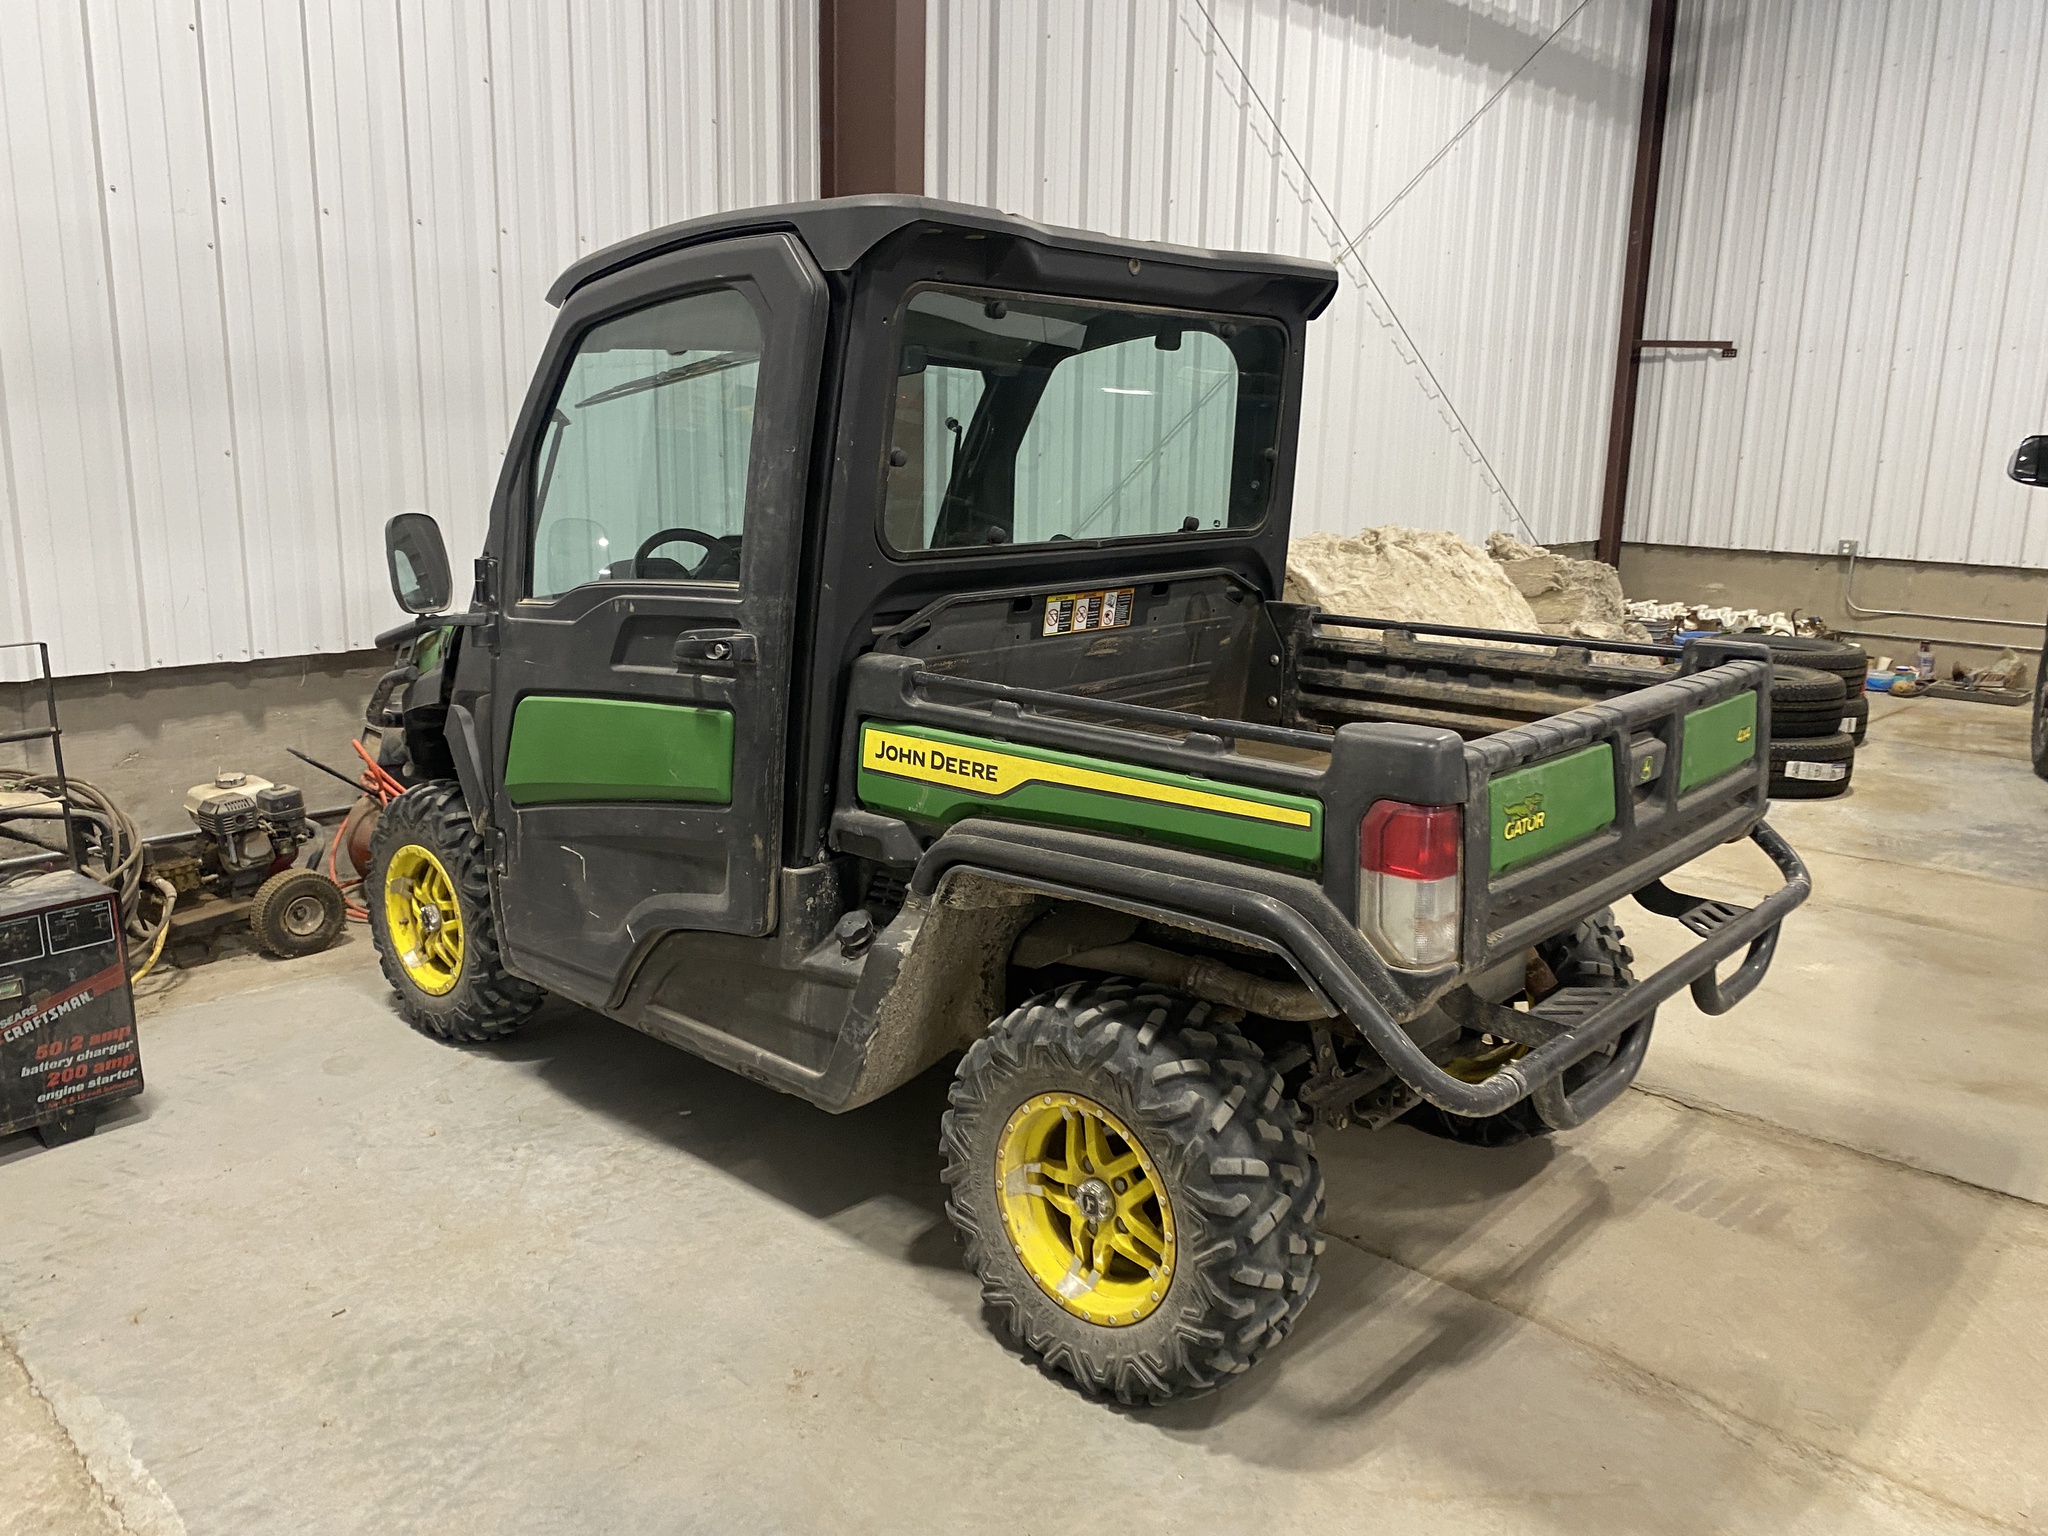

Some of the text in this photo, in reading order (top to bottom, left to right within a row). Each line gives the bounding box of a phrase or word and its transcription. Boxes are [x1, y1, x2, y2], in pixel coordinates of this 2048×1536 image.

[875, 740, 998, 782] JOHN DEERE
[1503, 811, 1546, 840] GATOR
[0, 1004, 38, 1030] SEARS
[3, 991, 91, 1043] CRAFTSMAN
[89, 1025, 131, 1046] amp
[20, 1040, 134, 1078] battery charger
[46, 1053, 135, 1088] 200 amp
[37, 1082, 85, 1103] engine
[88, 1067, 138, 1089] starter
